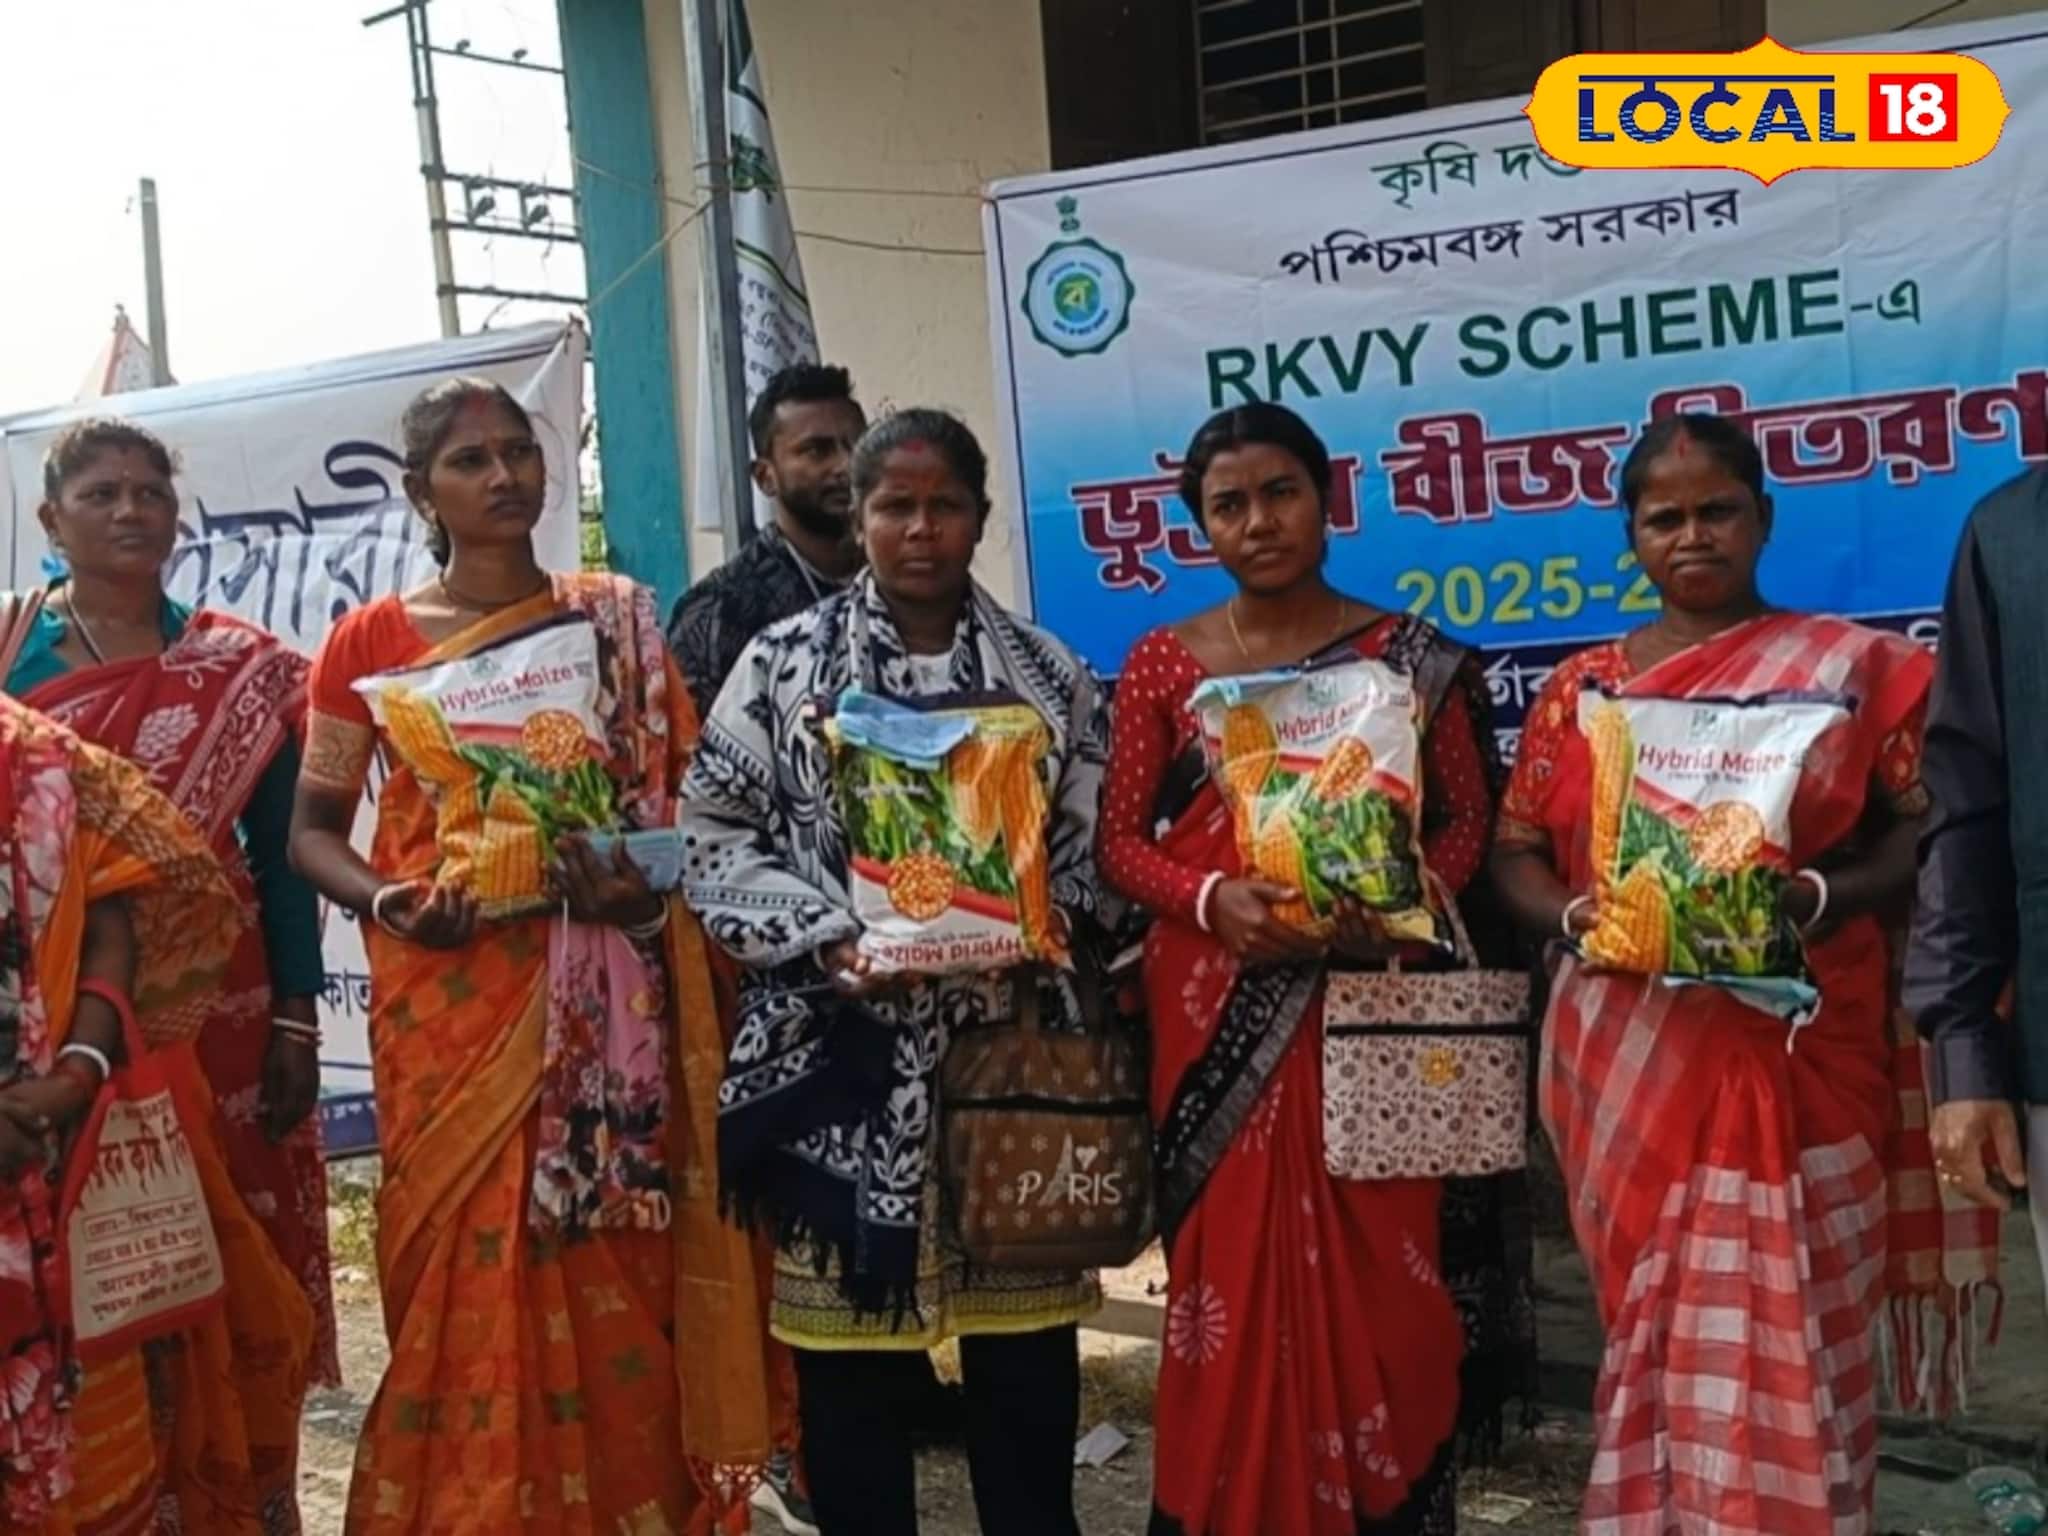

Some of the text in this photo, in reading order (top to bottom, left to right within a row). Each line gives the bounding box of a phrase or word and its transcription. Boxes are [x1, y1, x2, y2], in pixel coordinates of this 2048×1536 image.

[1370, 140, 1478, 208] কৃষি
[1279, 188, 1740, 285] পশ্চিমবঙ্গ সরকার
[1206, 269, 1922, 409] RKVY SCHEME-এ
[1379, 410, 1632, 525] বীজ
[1396, 551, 1663, 629] 2025-2
[438, 679, 511, 713] Hybrid
[514, 666, 574, 692] Maize
[1275, 707, 1336, 743] Hybrid
[1638, 743, 1714, 770] Hybrid
[1721, 751, 1787, 773] Maize
[883, 945, 943, 968] Maize
[949, 936, 1022, 960] Hybrid
[1017, 1131, 1123, 1206] PARIS
